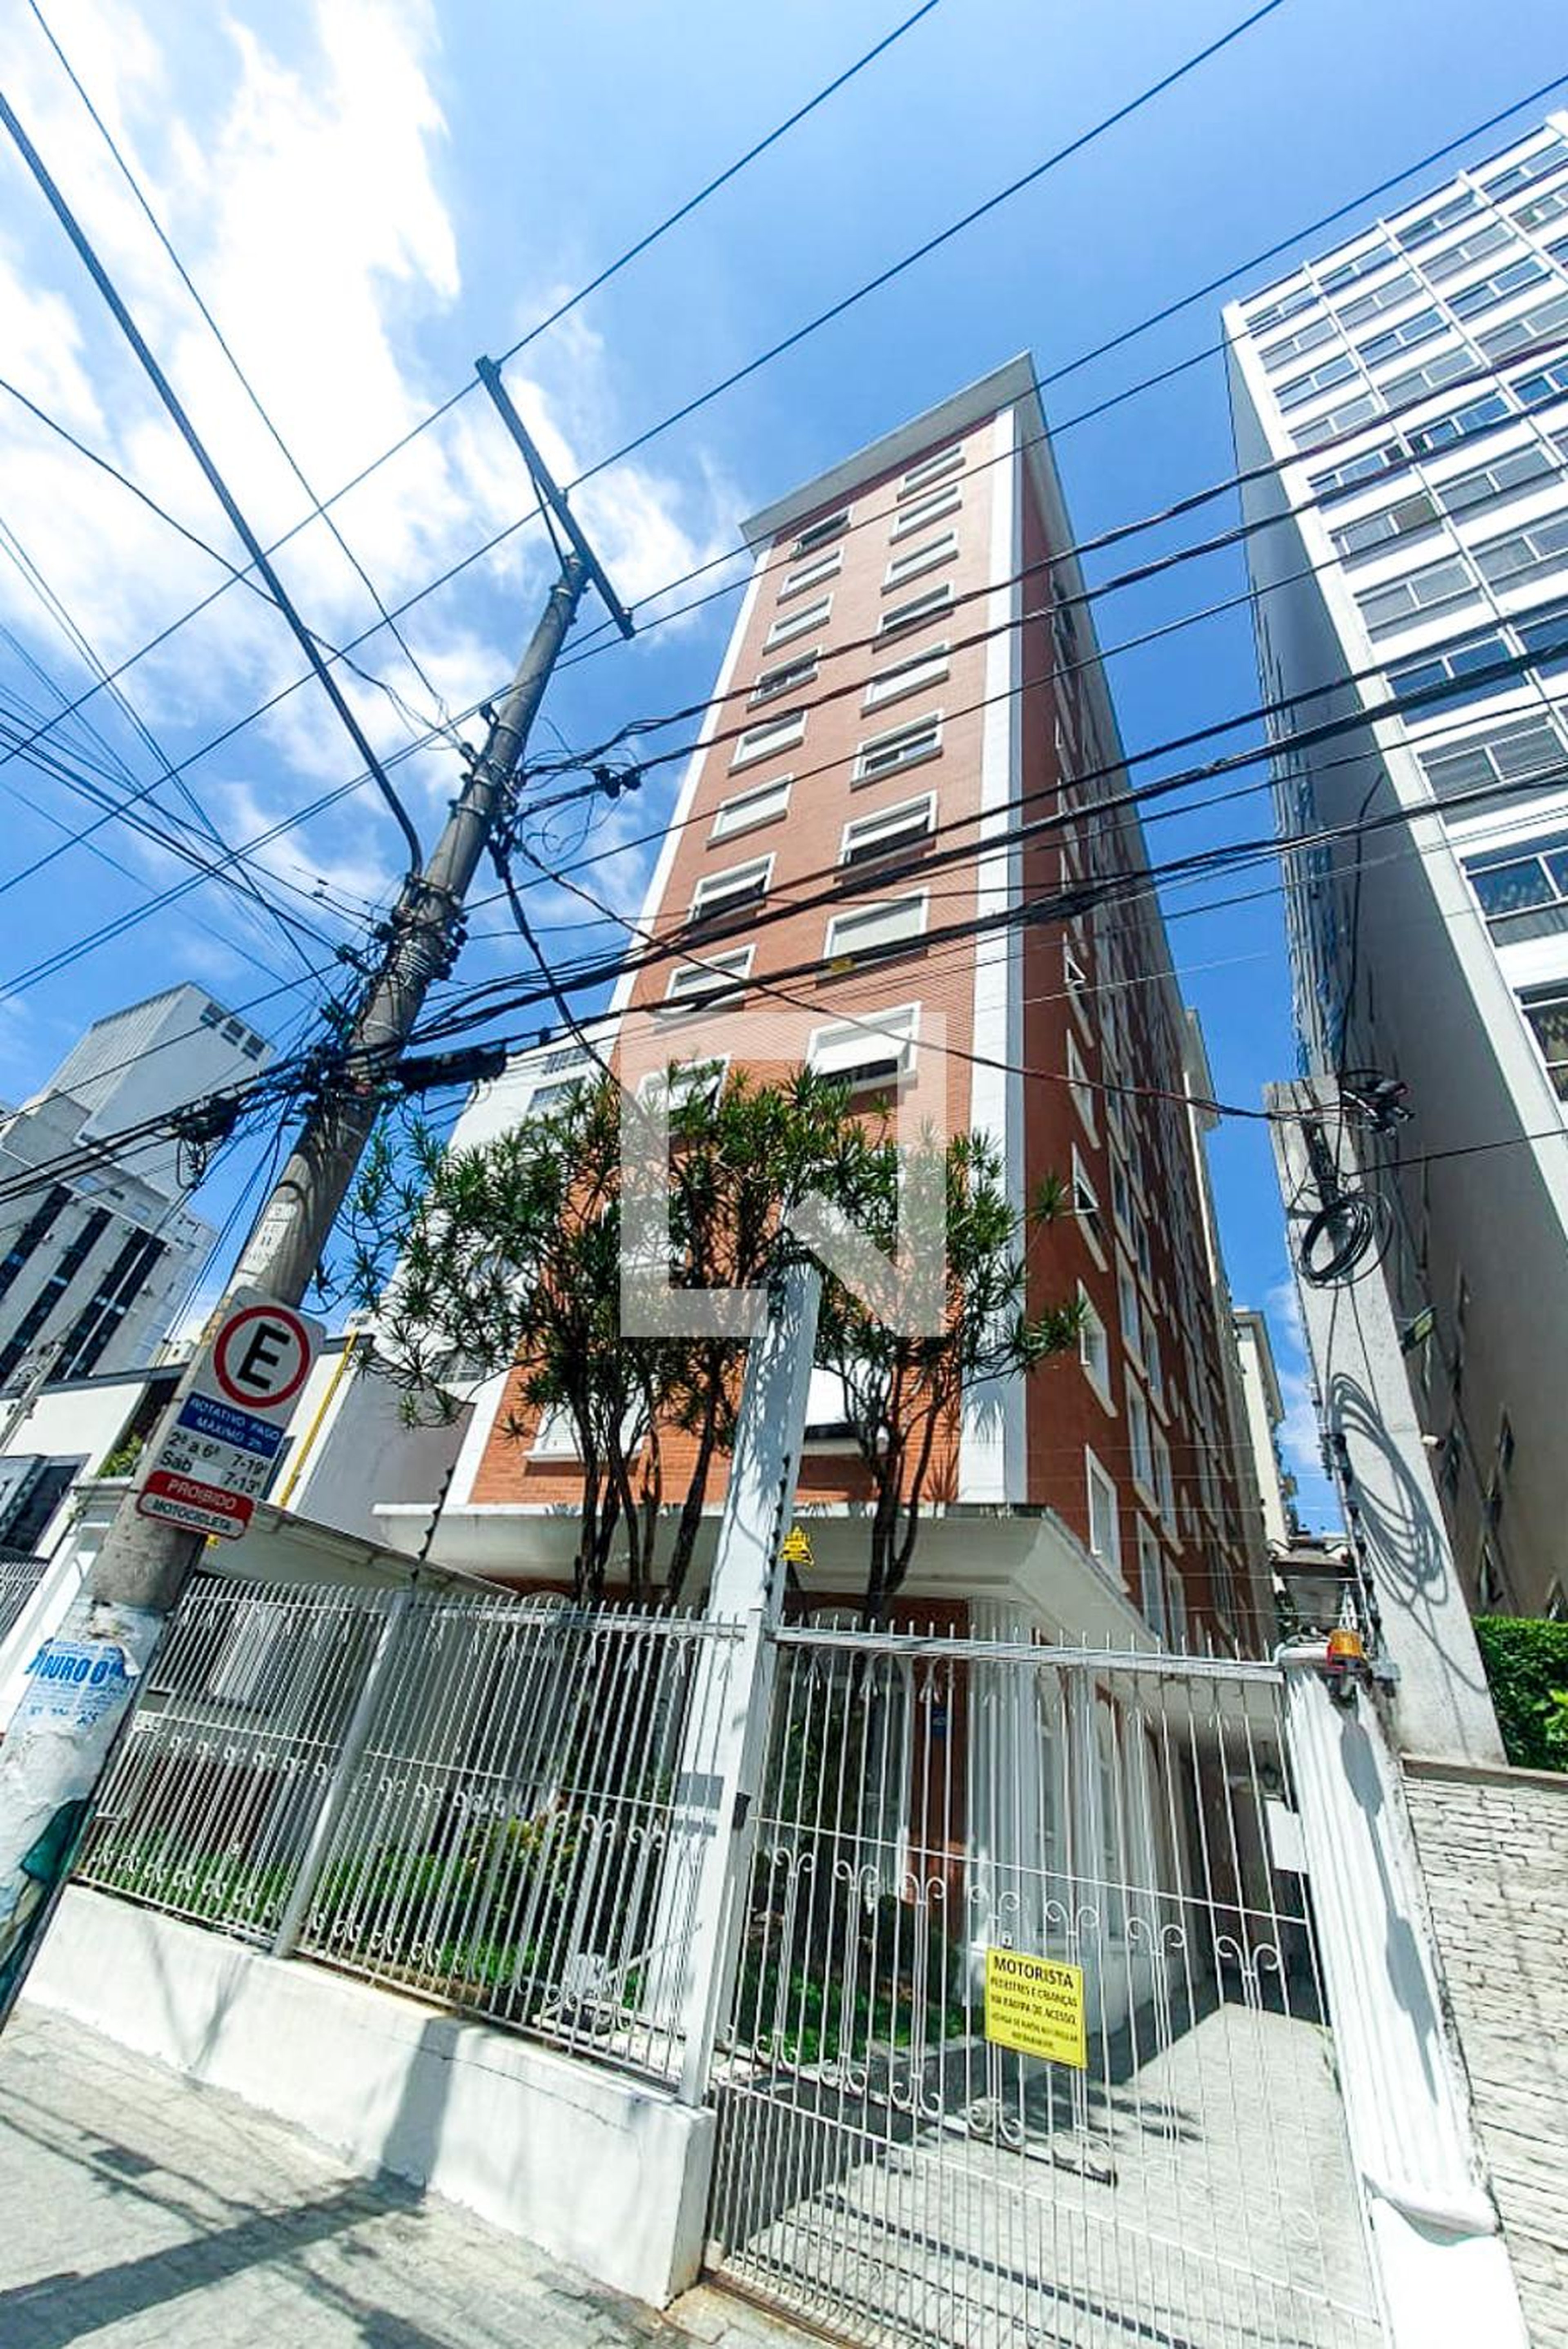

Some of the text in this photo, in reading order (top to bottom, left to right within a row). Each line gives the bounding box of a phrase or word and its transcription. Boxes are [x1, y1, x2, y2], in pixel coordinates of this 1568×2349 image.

[237, 1322, 291, 1389] E
[167, 1478, 237, 1510] PROIBIDO
[994, 1955, 1074, 1989] MOTORISTA
